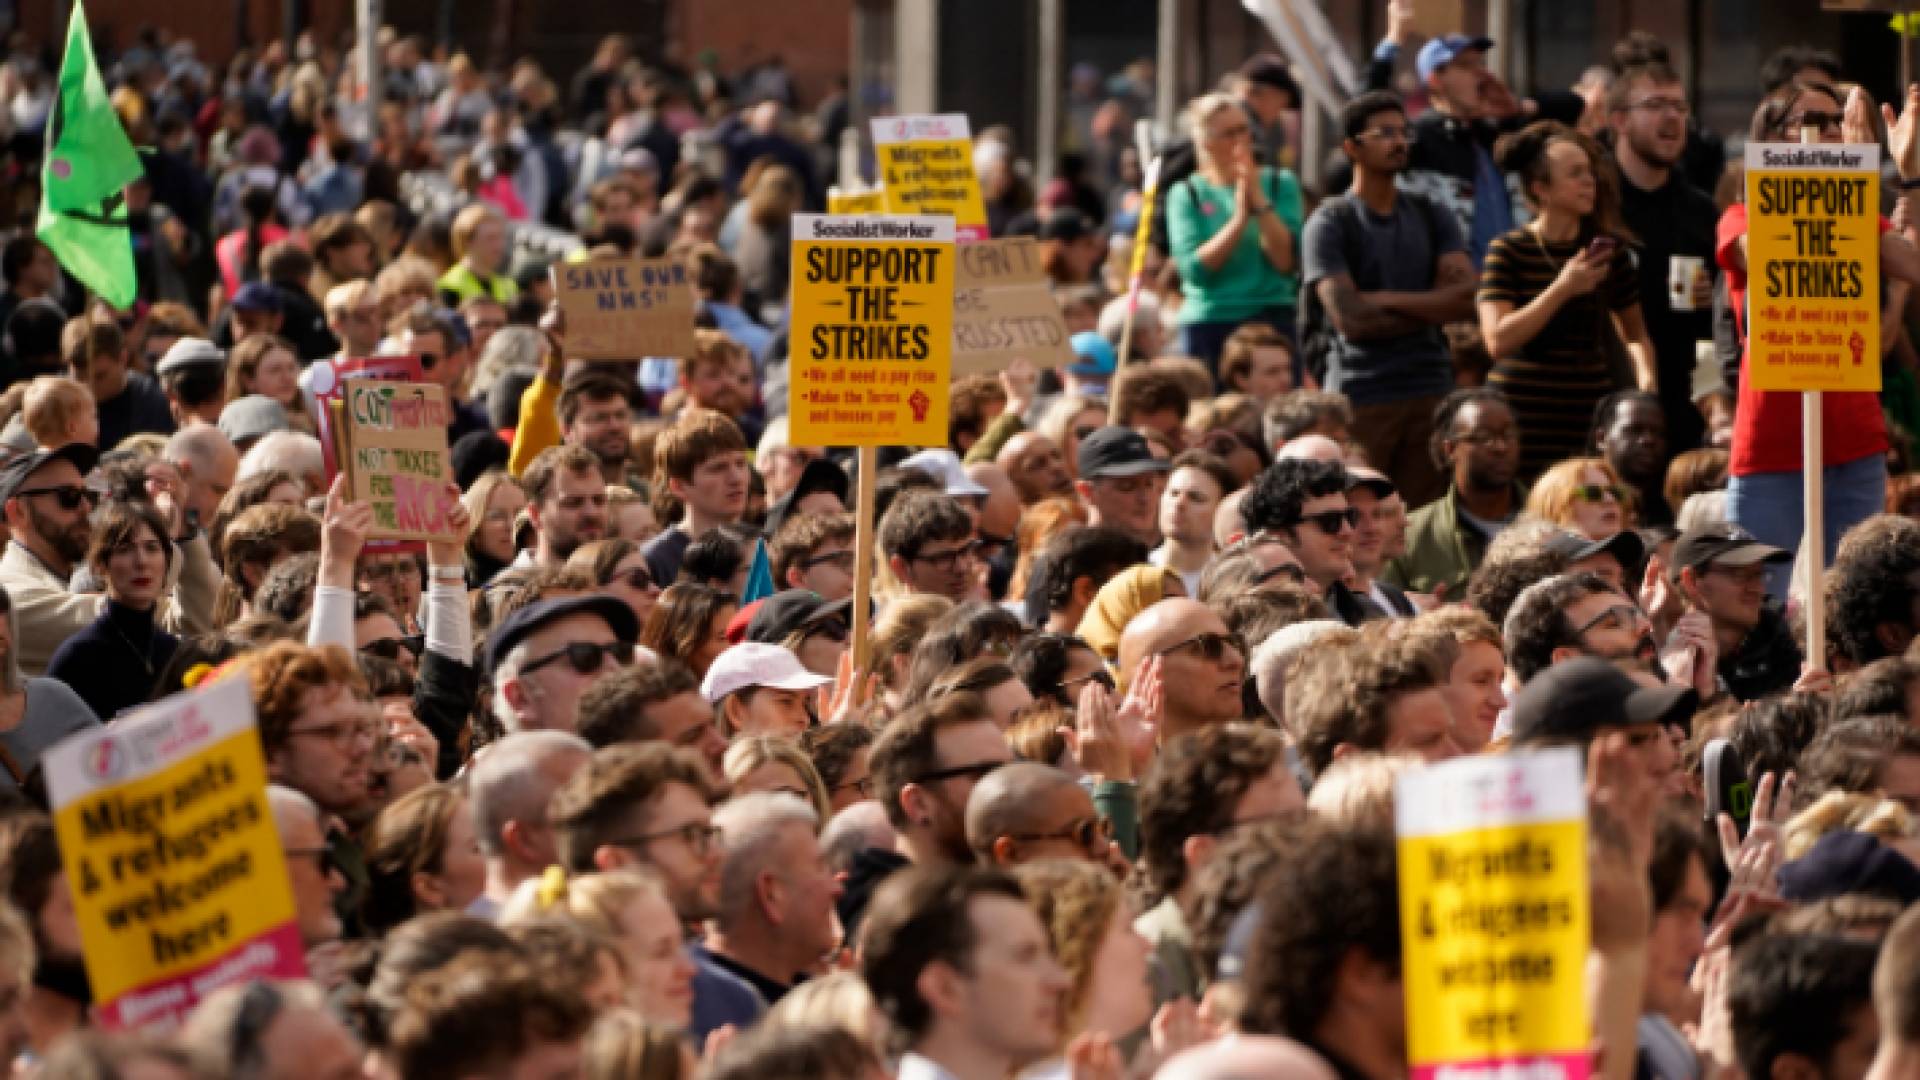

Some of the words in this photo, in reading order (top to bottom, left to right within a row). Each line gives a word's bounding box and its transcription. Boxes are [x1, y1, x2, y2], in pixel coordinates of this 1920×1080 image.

[1758, 176, 1869, 216] SUPPORT
[1793, 219, 1837, 257] THE
[566, 267, 629, 291] SAVE
[641, 264, 686, 287] OUR
[807, 246, 942, 284] SUPPORT
[1766, 259, 1864, 298] STRIKES
[845, 286, 899, 321] THE
[811, 324, 930, 360] STRIKES
[392, 449, 441, 478] TAXES
[80, 758, 236, 840] Migrants
[110, 797, 261, 881] refugees
[104, 852, 253, 931] welcome
[151, 911, 230, 965] here
